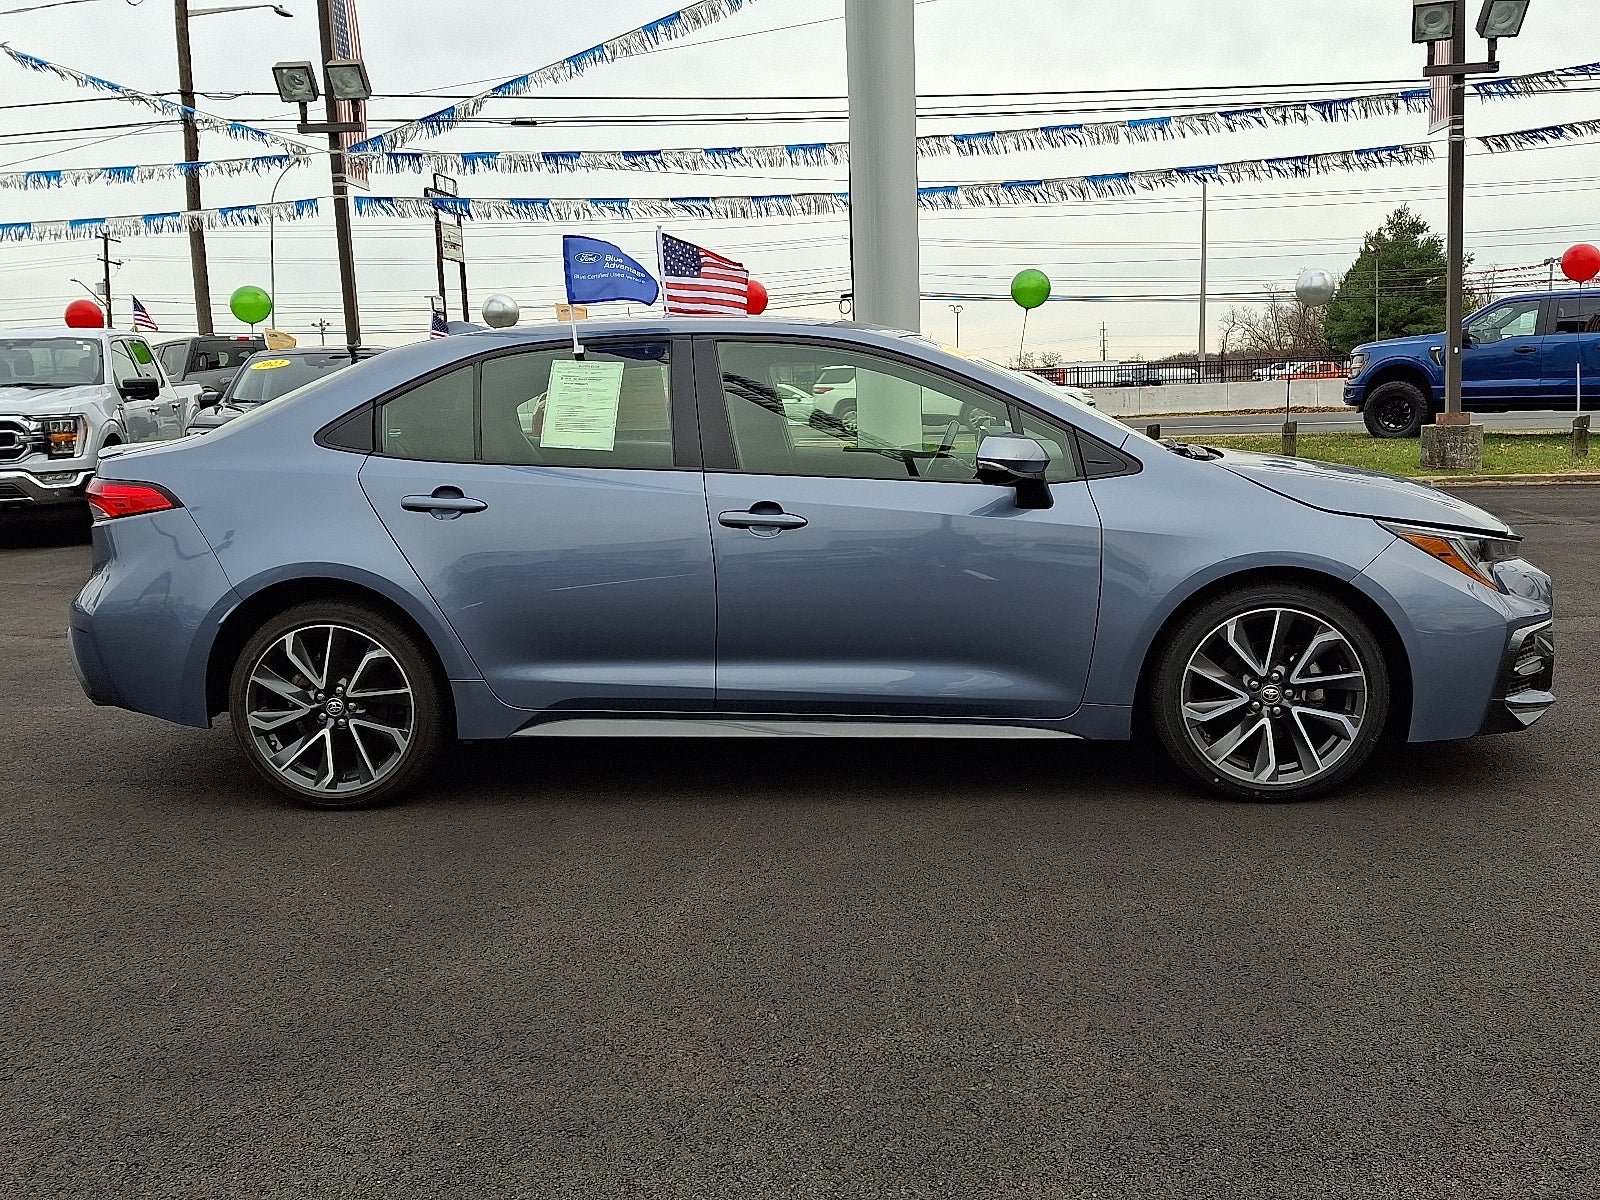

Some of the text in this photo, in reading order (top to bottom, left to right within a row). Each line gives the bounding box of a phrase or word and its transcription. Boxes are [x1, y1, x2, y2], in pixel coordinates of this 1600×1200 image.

[578, 252, 600, 262] Ford
[604, 254, 623, 264] Blue
[604, 262, 646, 278] Advantage
[587, 272, 609, 280] Certified
